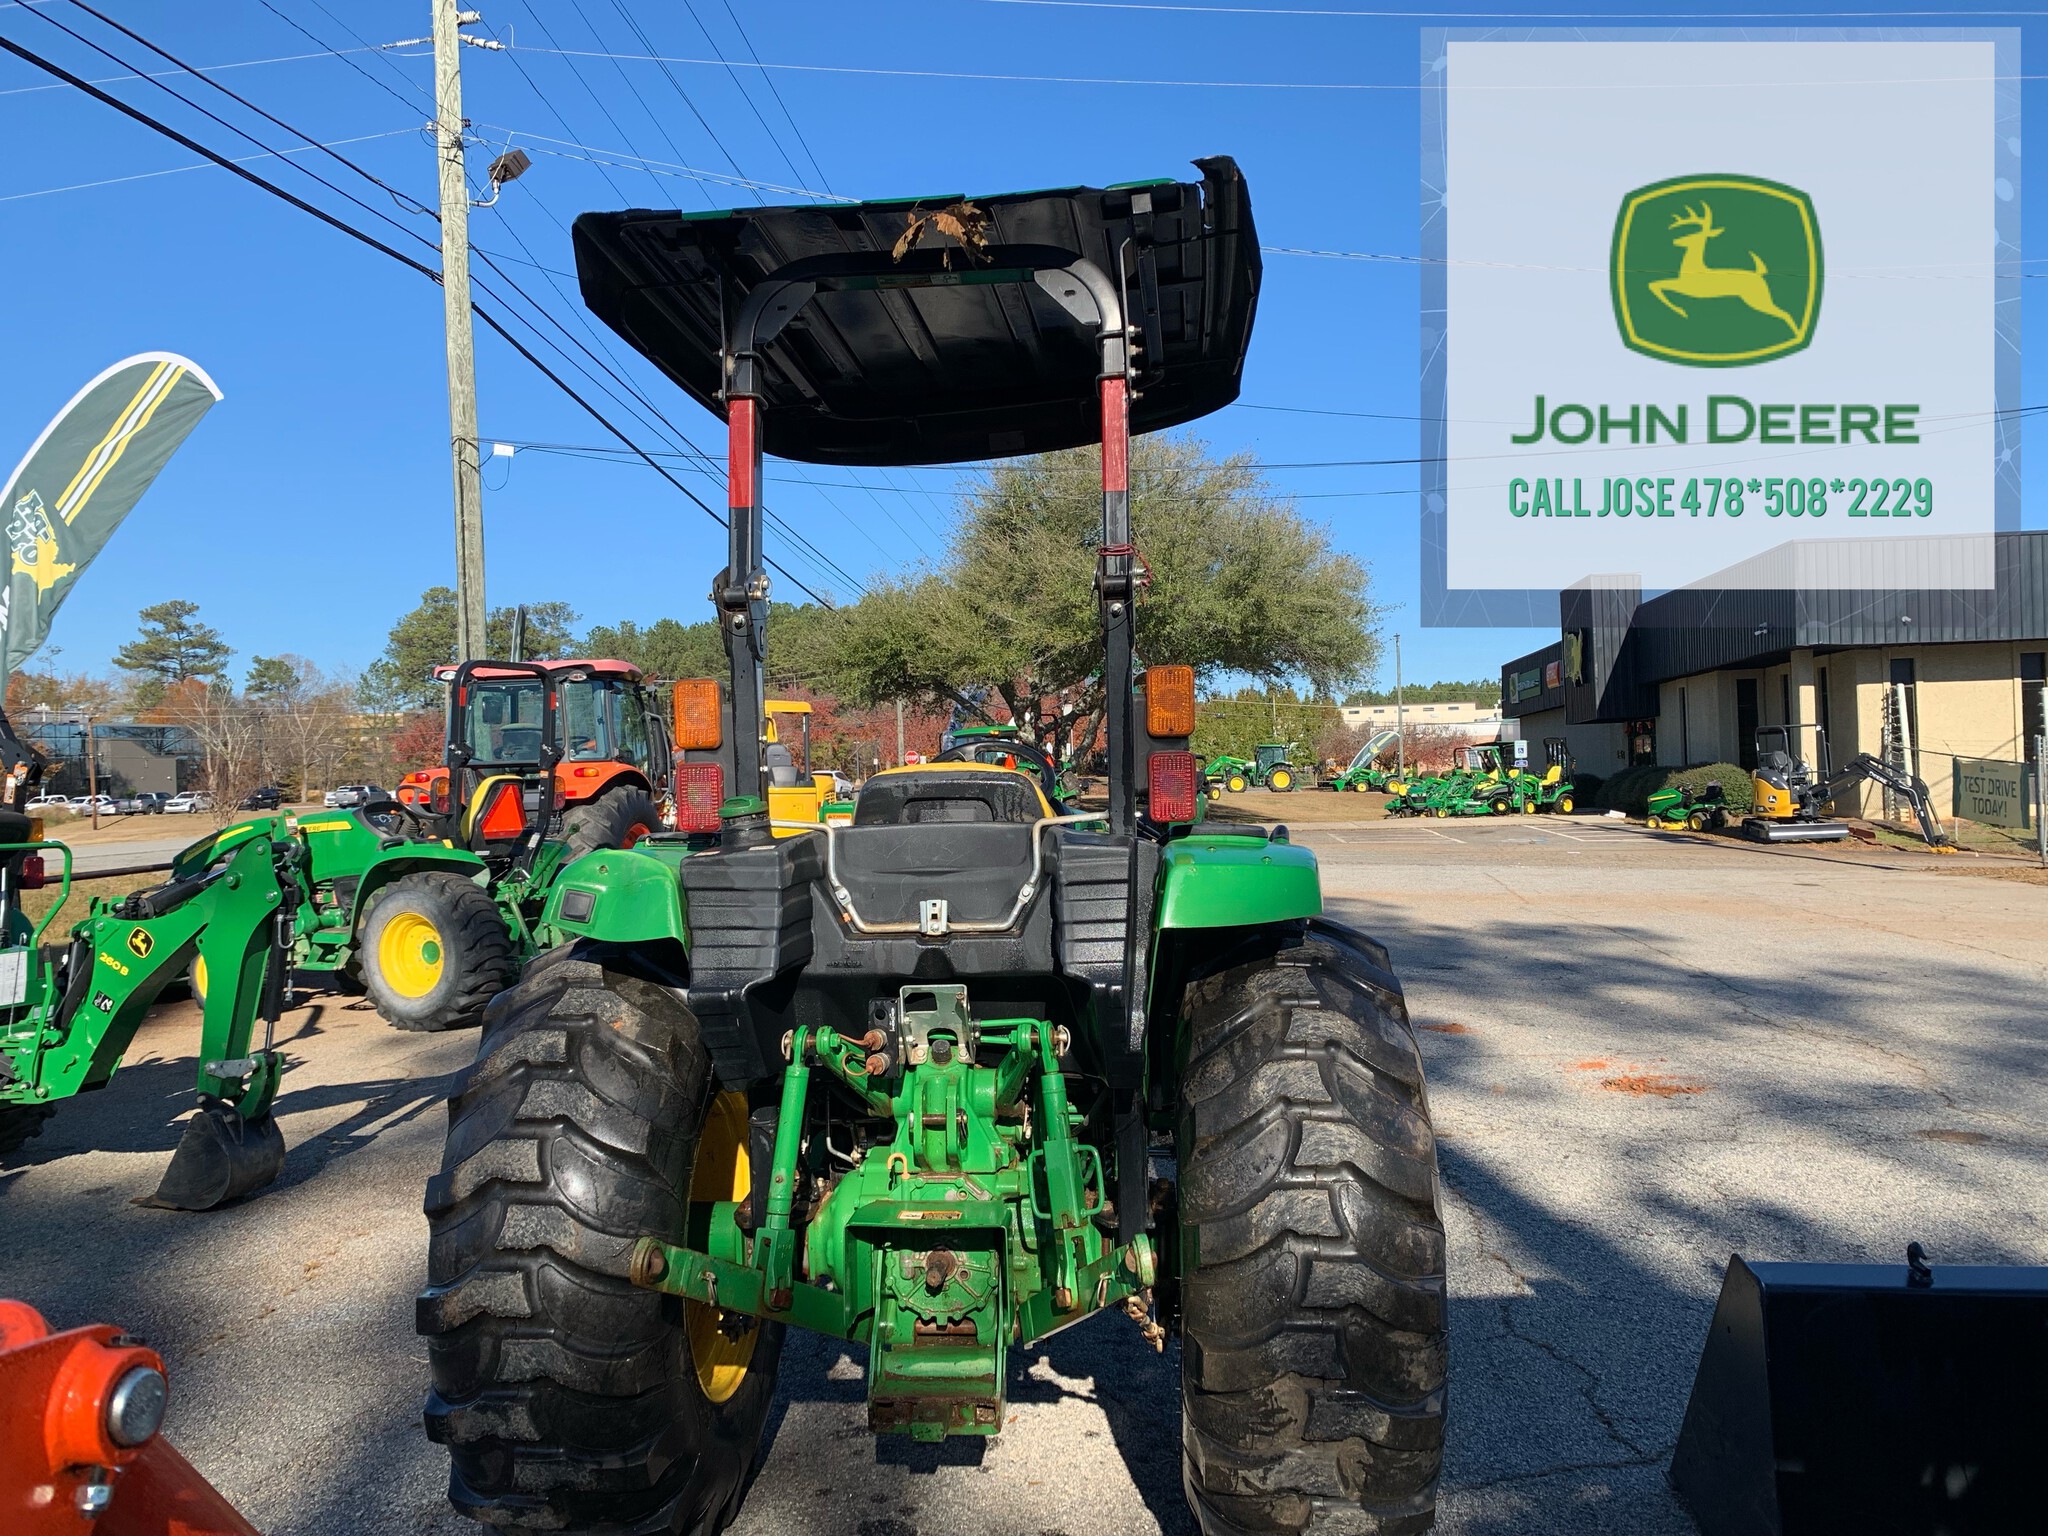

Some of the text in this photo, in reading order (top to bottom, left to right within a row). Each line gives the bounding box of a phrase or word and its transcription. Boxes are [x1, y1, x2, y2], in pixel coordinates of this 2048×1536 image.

[1963, 775, 2017, 799] TEST DRIVE
[1972, 796, 2008, 818] TODAY!
